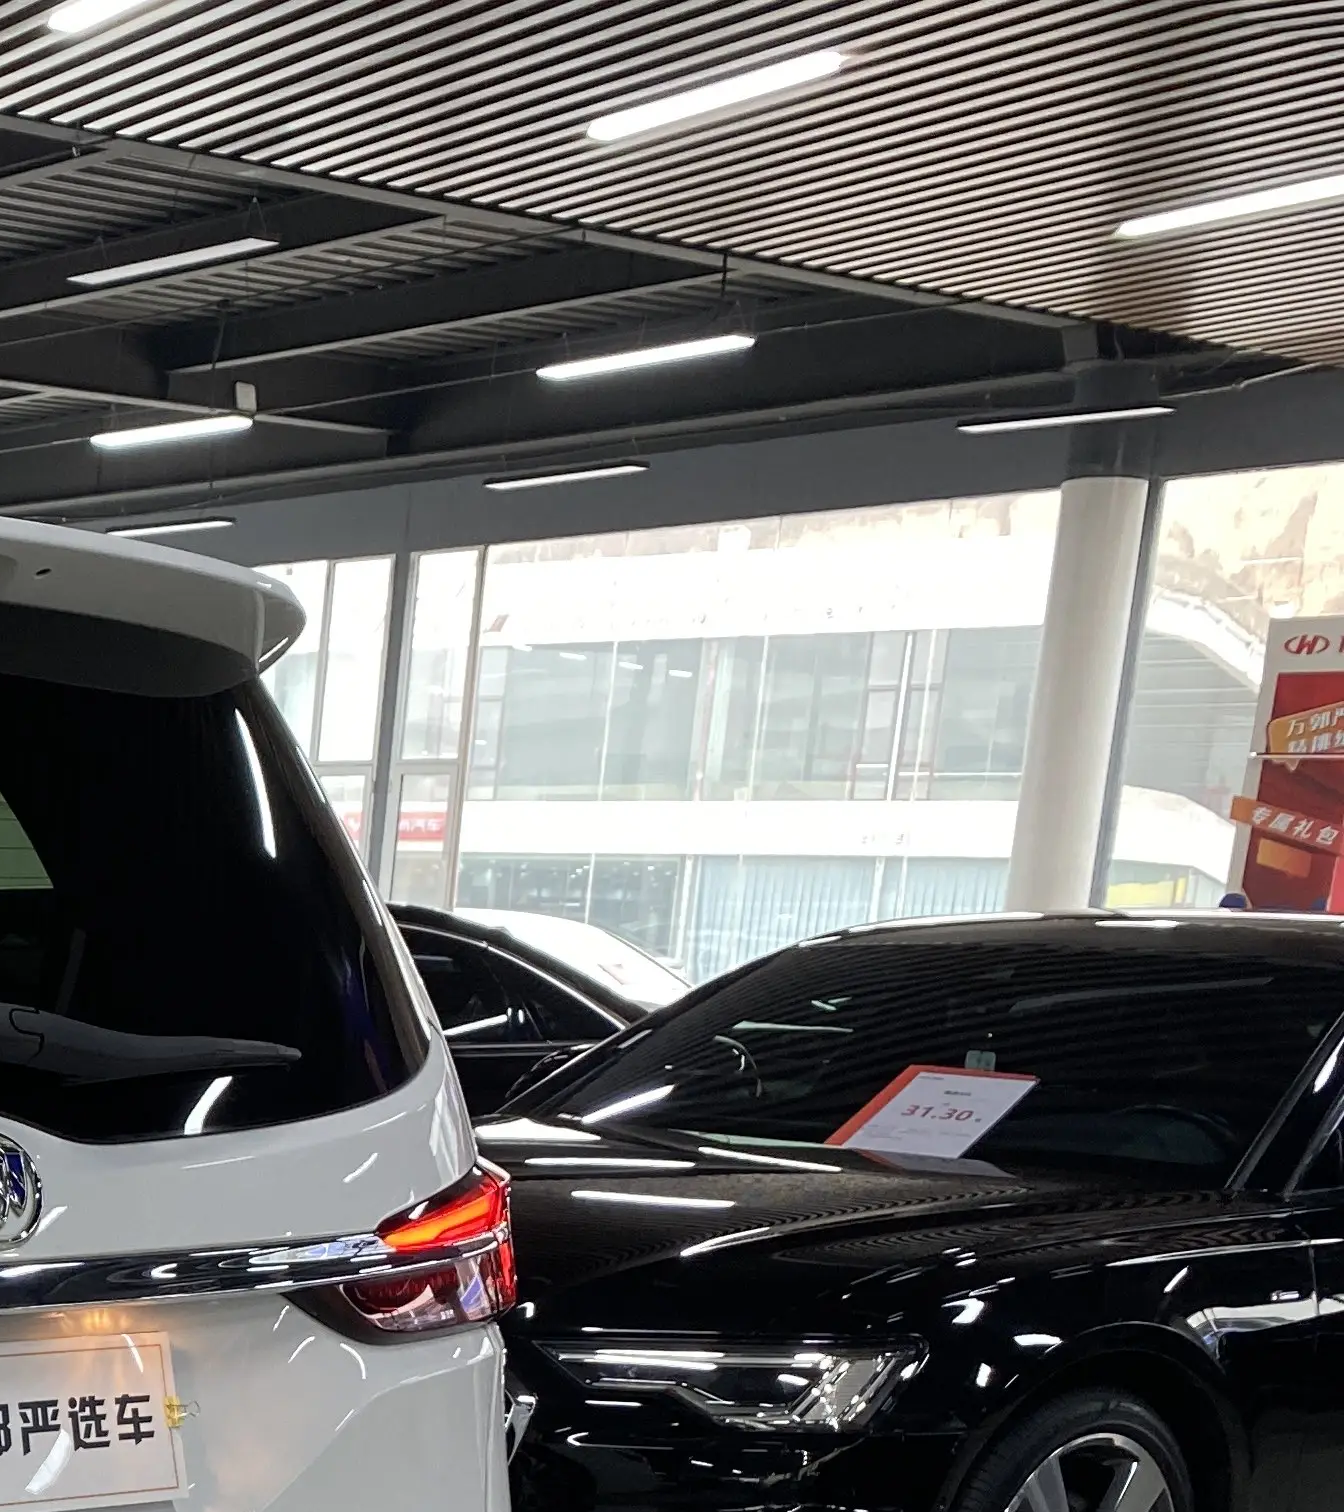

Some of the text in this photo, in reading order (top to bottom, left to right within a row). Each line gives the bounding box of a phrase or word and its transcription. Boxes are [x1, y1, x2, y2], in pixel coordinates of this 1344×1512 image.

[1252, 806, 1340, 845] 专属礼包
[900, 1104, 974, 1122] 31.30
